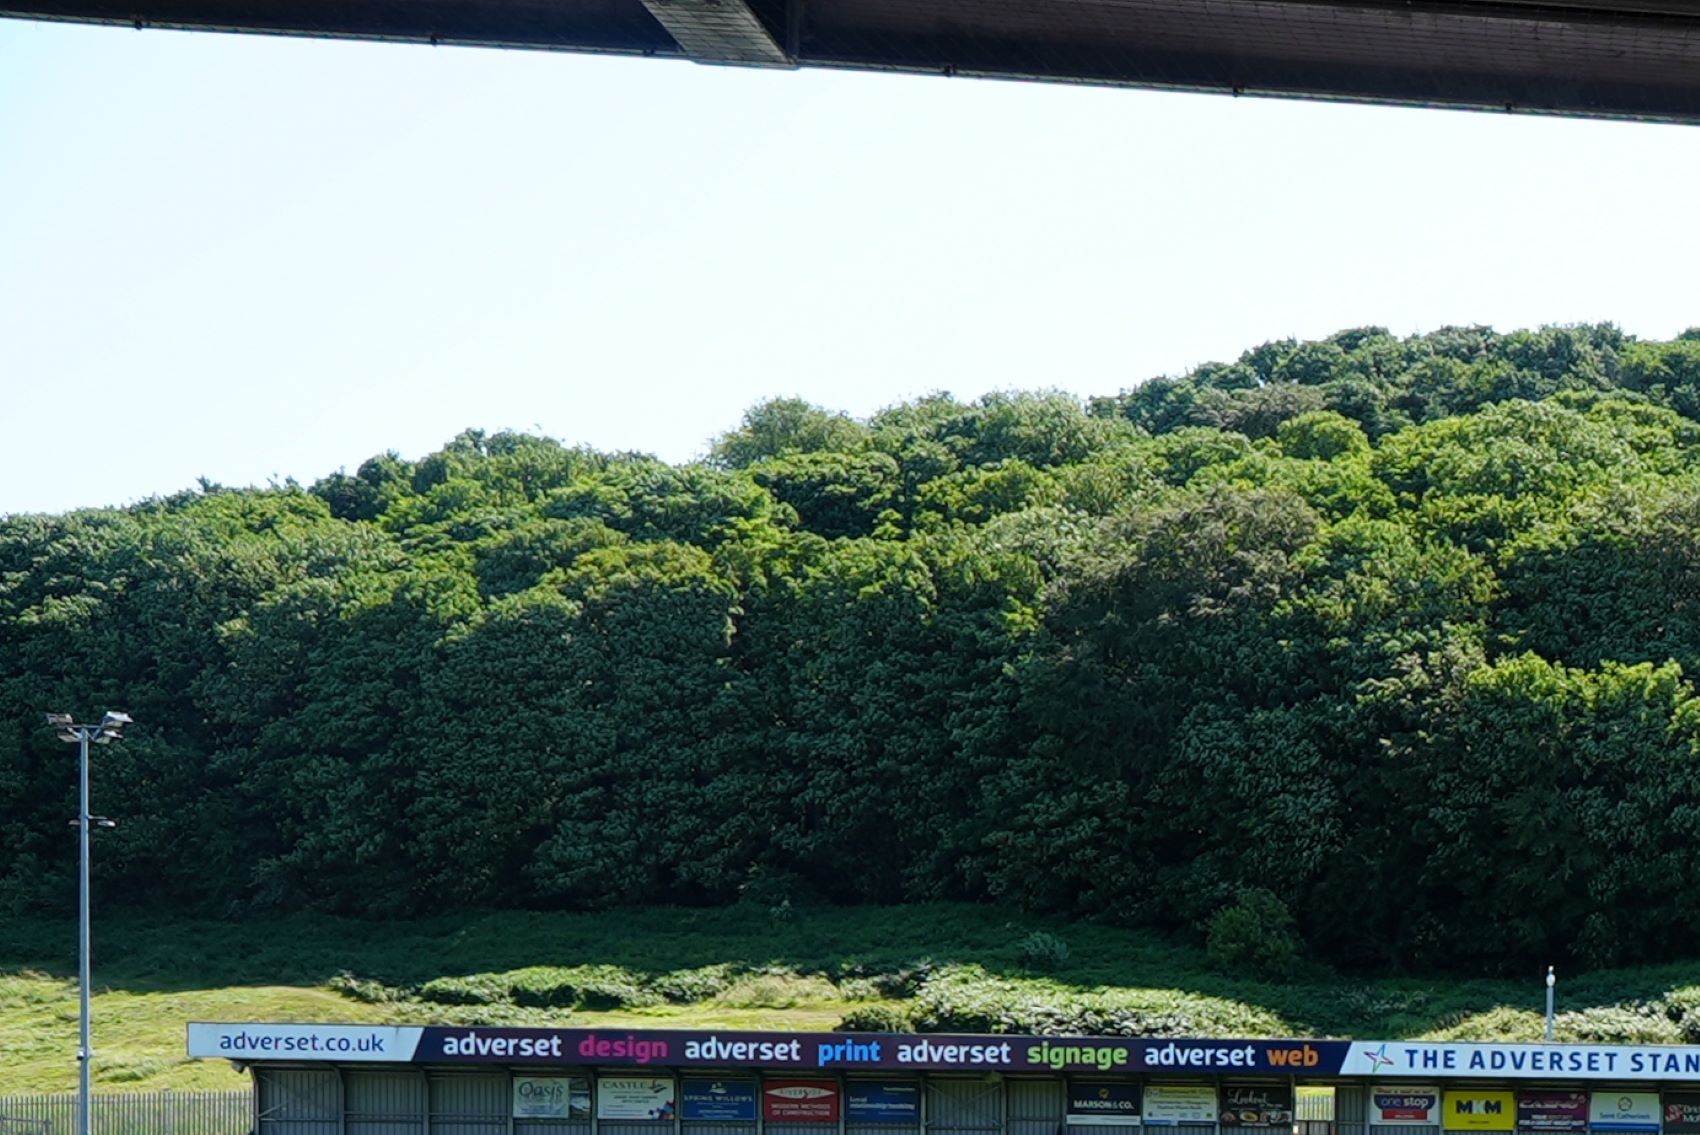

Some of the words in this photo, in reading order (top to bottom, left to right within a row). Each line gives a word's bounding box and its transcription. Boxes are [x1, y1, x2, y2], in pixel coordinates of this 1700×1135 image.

[220, 1031, 385, 1053] adverset.co.uk
[443, 1032, 562, 1056] adverset
[579, 1037, 669, 1064] design
[685, 1035, 801, 1060] adverset
[818, 1038, 881, 1065] print
[897, 1038, 1012, 1063] adverset
[1027, 1041, 1128, 1068] signage
[1145, 1042, 1256, 1067] adverset
[1267, 1044, 1319, 1067] web
[1404, 1048, 1457, 1069] THE
[1469, 1049, 1619, 1073] ADVERSET
[1381, 1098, 1402, 1106] one
[1403, 1097, 1430, 1109] stop
[1456, 1100, 1502, 1114] MKM
